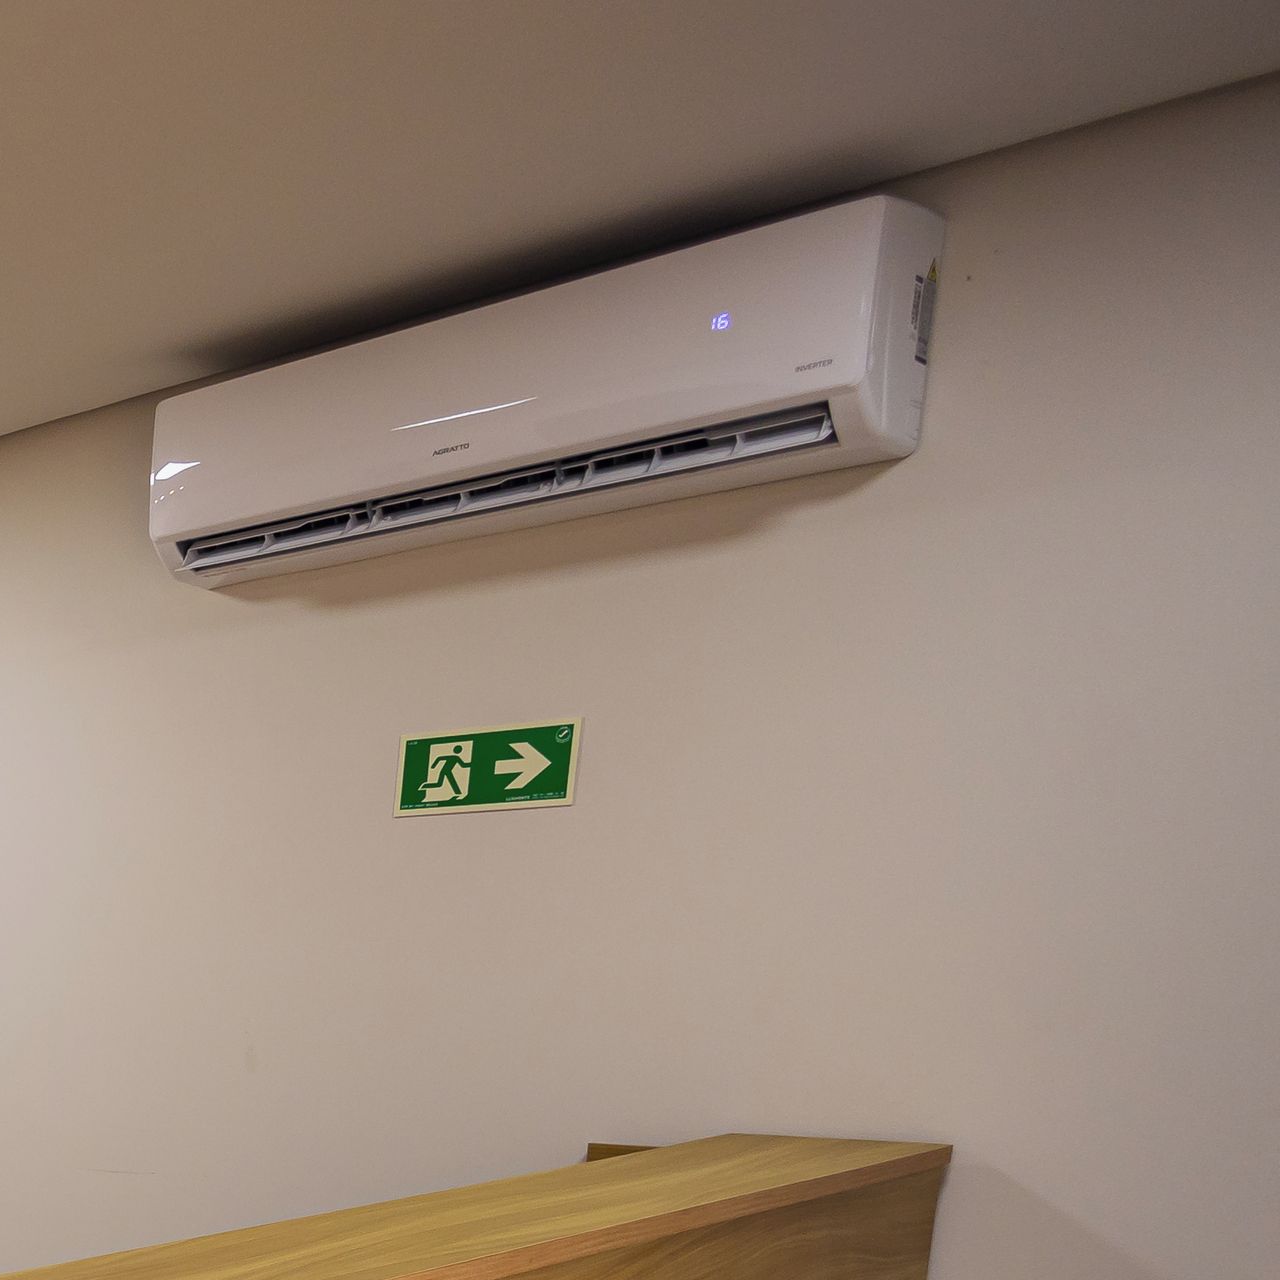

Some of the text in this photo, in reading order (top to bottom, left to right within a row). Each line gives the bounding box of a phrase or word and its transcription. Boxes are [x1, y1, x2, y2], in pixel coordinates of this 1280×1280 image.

[711, 312, 730, 330] 16
[794, 358, 833, 373] INVERTER
[432, 442, 470, 457] AGRATTO
